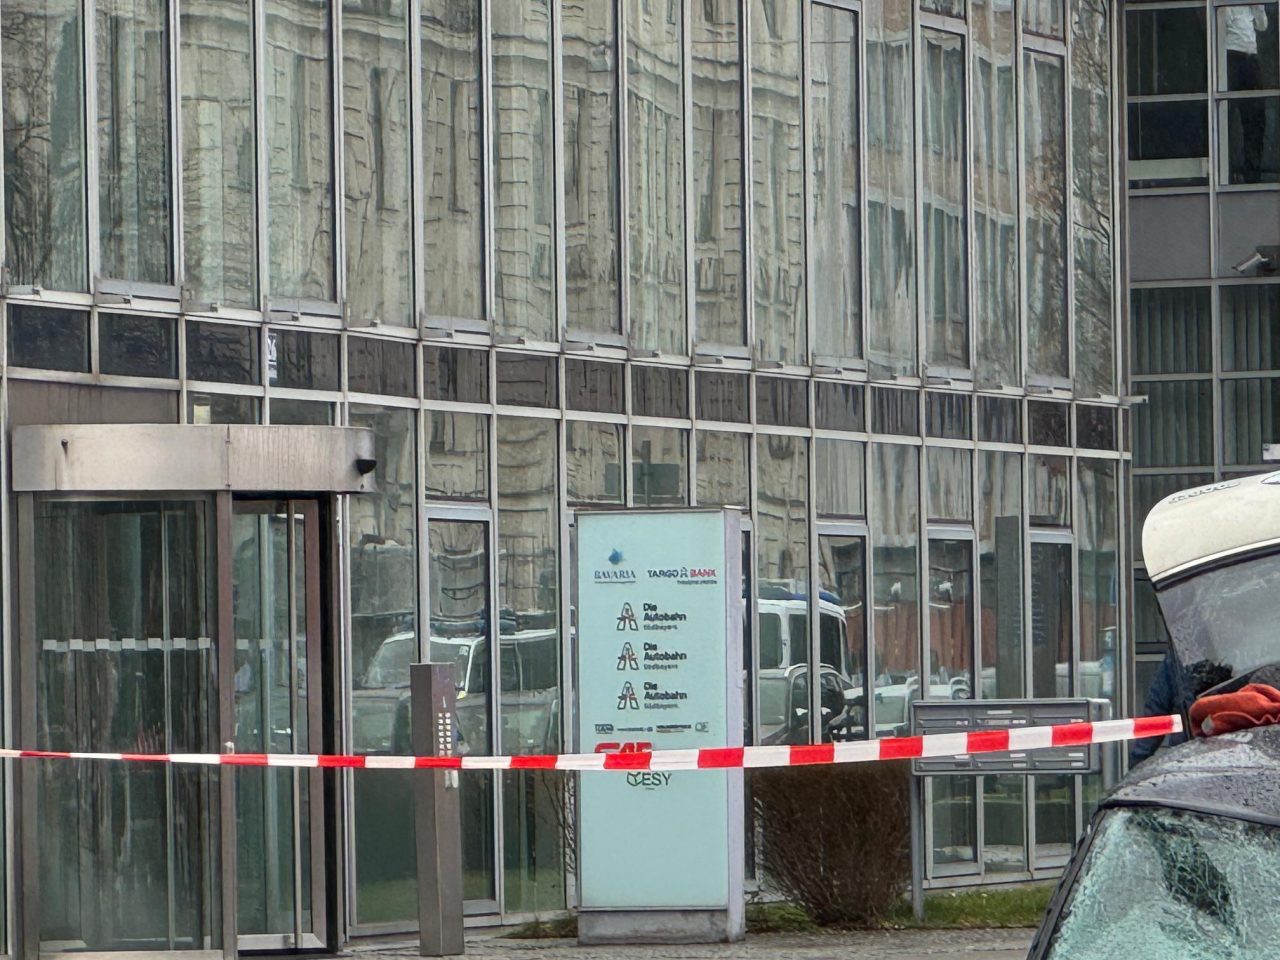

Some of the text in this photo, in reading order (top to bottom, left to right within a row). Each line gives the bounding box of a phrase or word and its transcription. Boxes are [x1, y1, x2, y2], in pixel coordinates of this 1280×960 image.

[643, 603, 657, 611] Die
[643, 613, 686, 622] Autobahn
[643, 643, 657, 651] Die
[644, 652, 687, 661] Autobahn
[643, 682, 658, 690] Die
[644, 691, 688, 700] Autobahn
